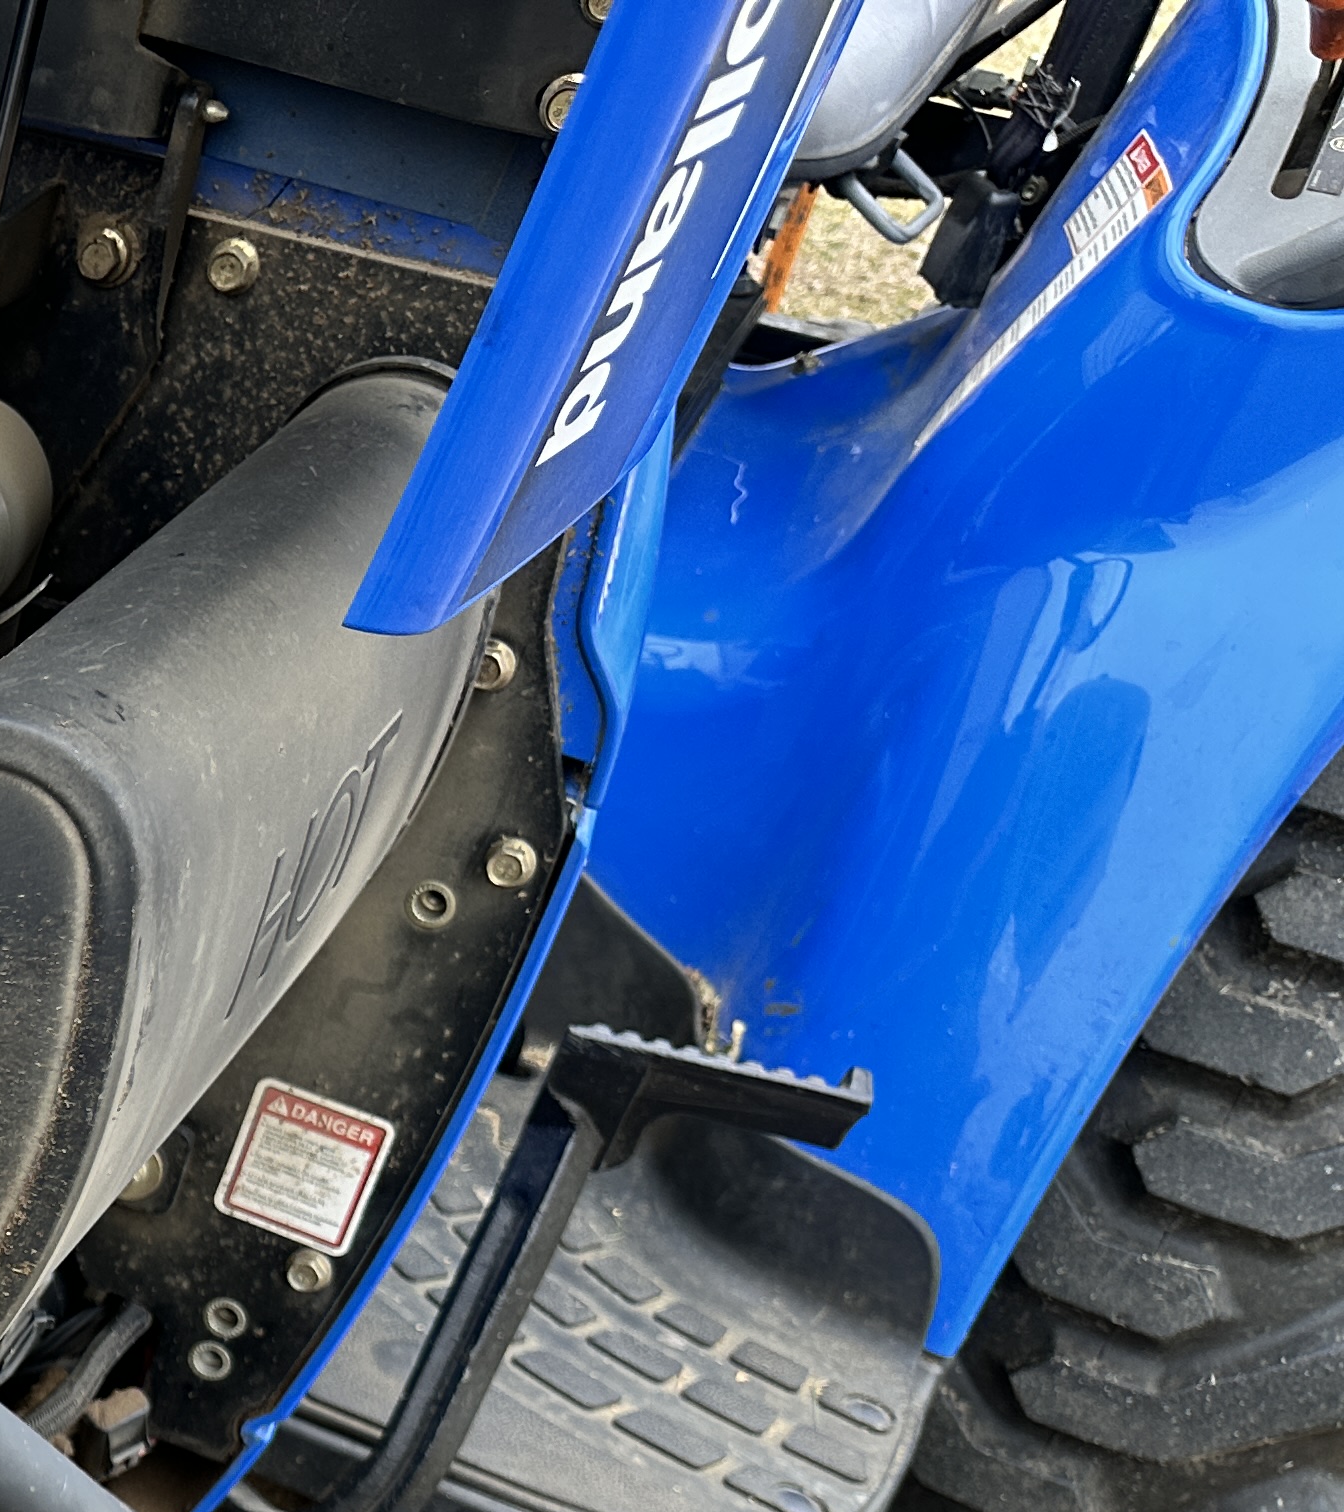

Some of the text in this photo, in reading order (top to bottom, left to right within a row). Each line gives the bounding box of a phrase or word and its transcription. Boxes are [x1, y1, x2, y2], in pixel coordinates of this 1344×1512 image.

[536, 0, 777, 466] olland
[225, 709, 403, 1020] HOT
[290, 1099, 375, 1150] DANGER
